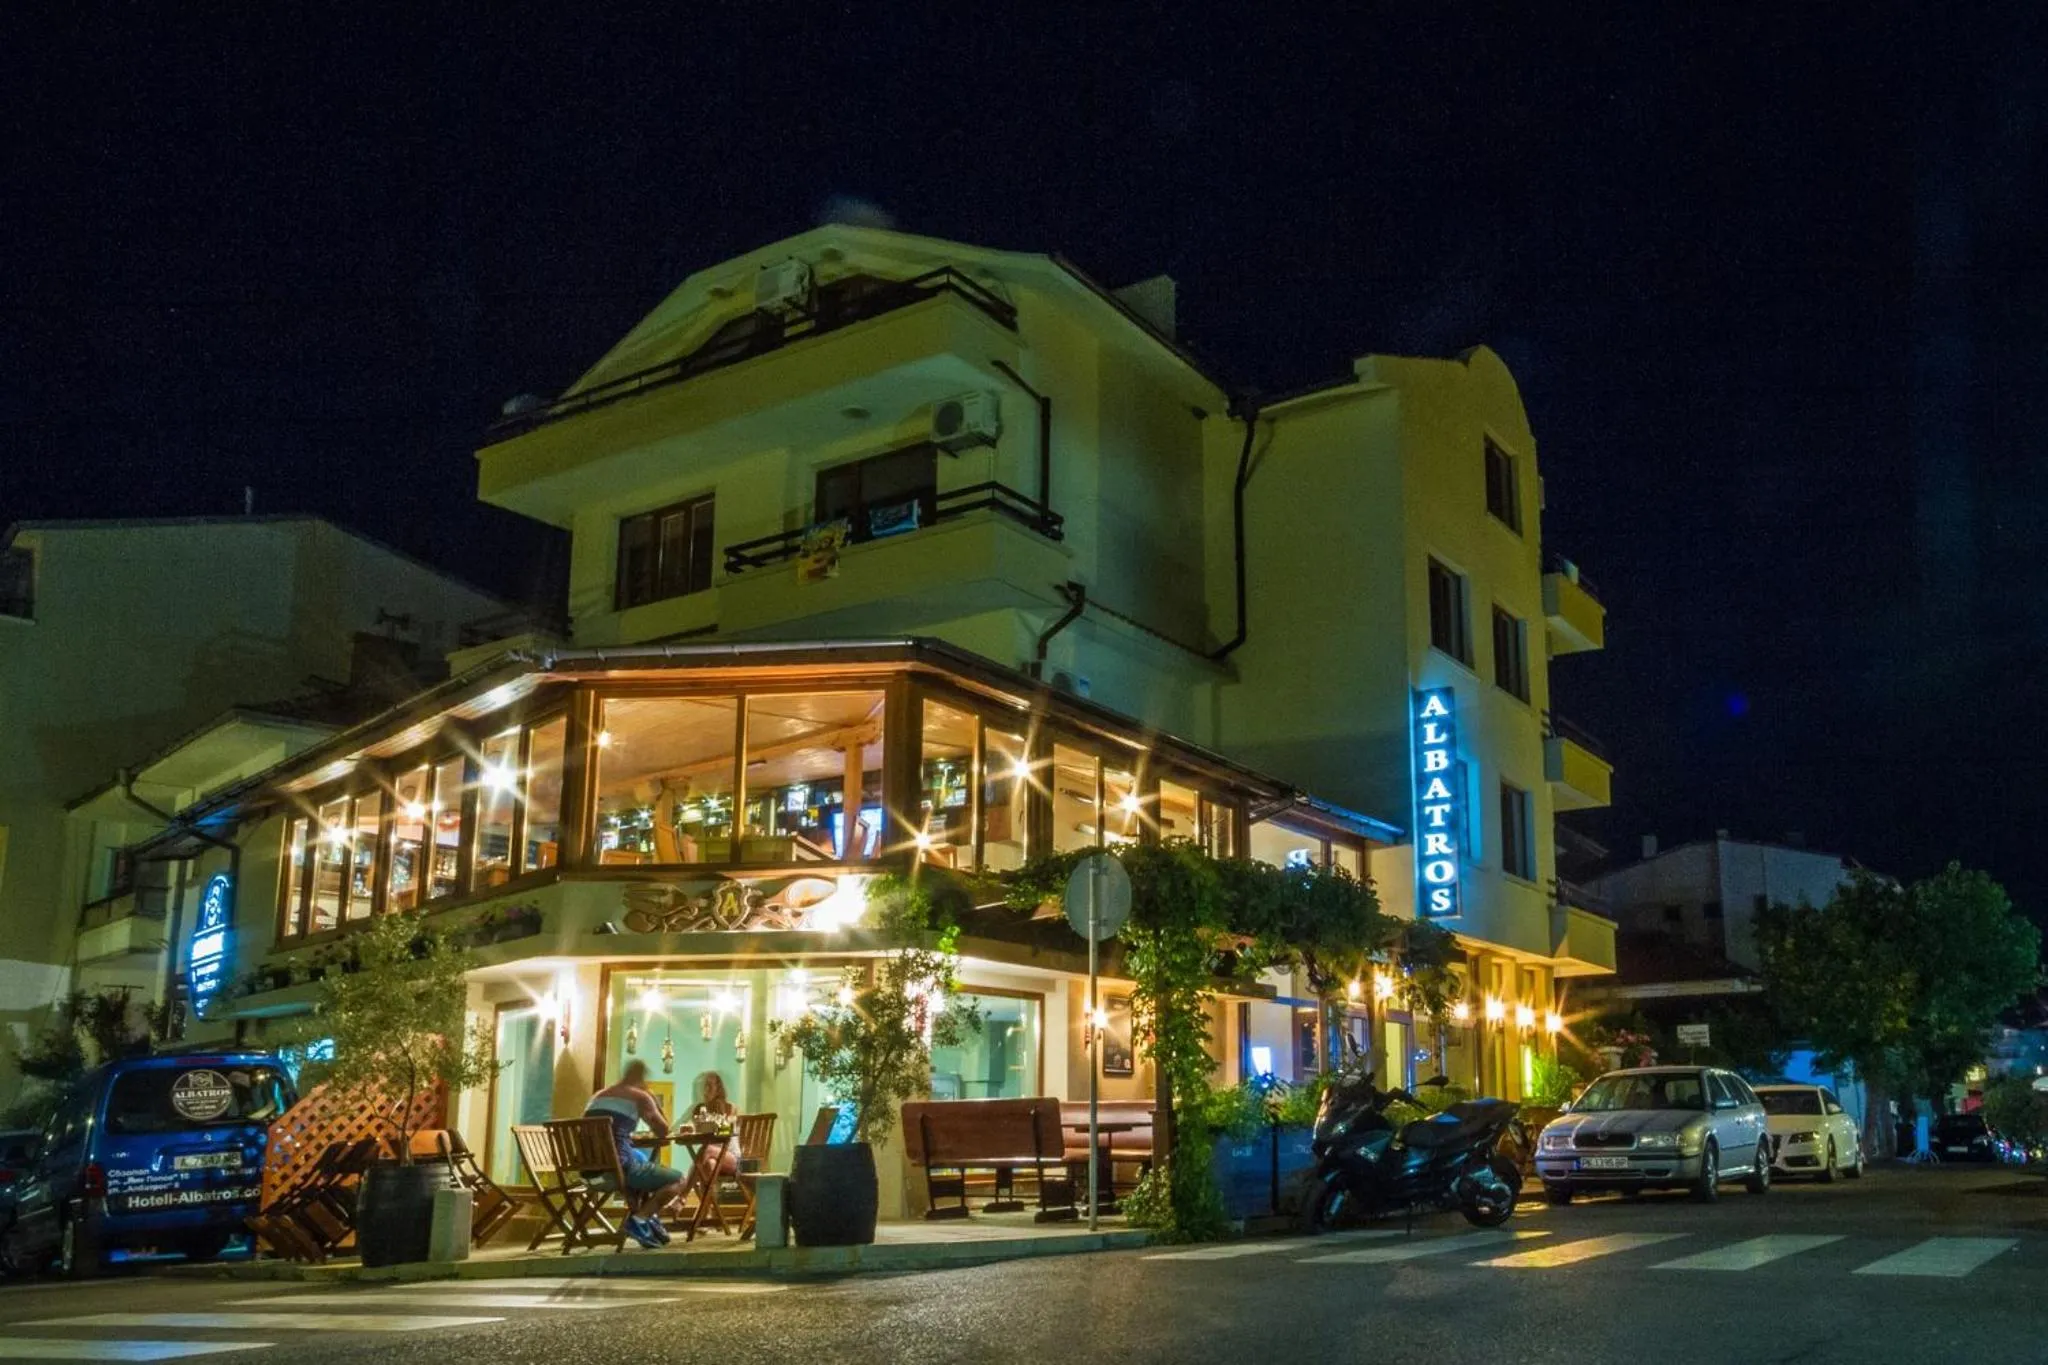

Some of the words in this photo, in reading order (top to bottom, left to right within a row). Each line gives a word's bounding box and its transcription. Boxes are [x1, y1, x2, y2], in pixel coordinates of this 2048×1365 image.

[1419, 694, 1455, 913] ALBATROS
[720, 892, 740, 918] A
[174, 1089, 231, 1099] ALBATROS
